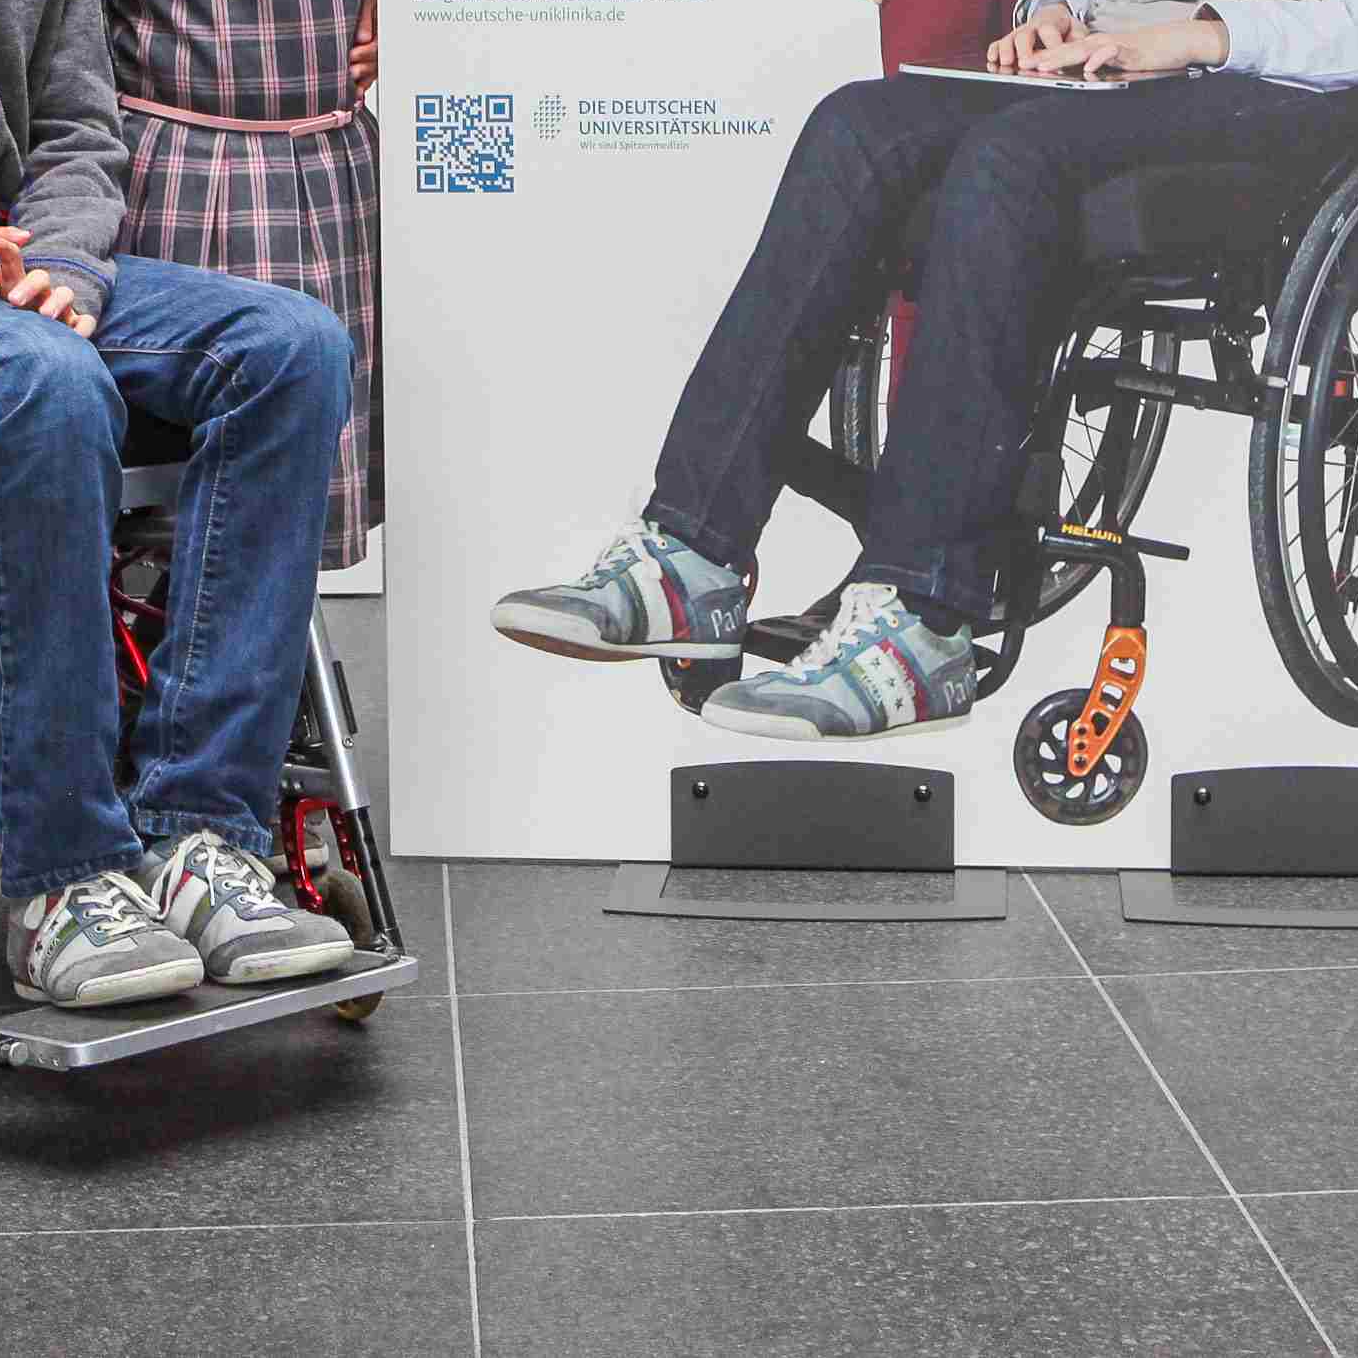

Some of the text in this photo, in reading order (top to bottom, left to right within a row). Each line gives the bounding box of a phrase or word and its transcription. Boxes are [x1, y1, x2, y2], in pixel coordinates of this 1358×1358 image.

[413, 6, 627, 24] www.deutsche-uniklinika.de
[578, 100, 717, 115] DIE DEUTSCHEN
